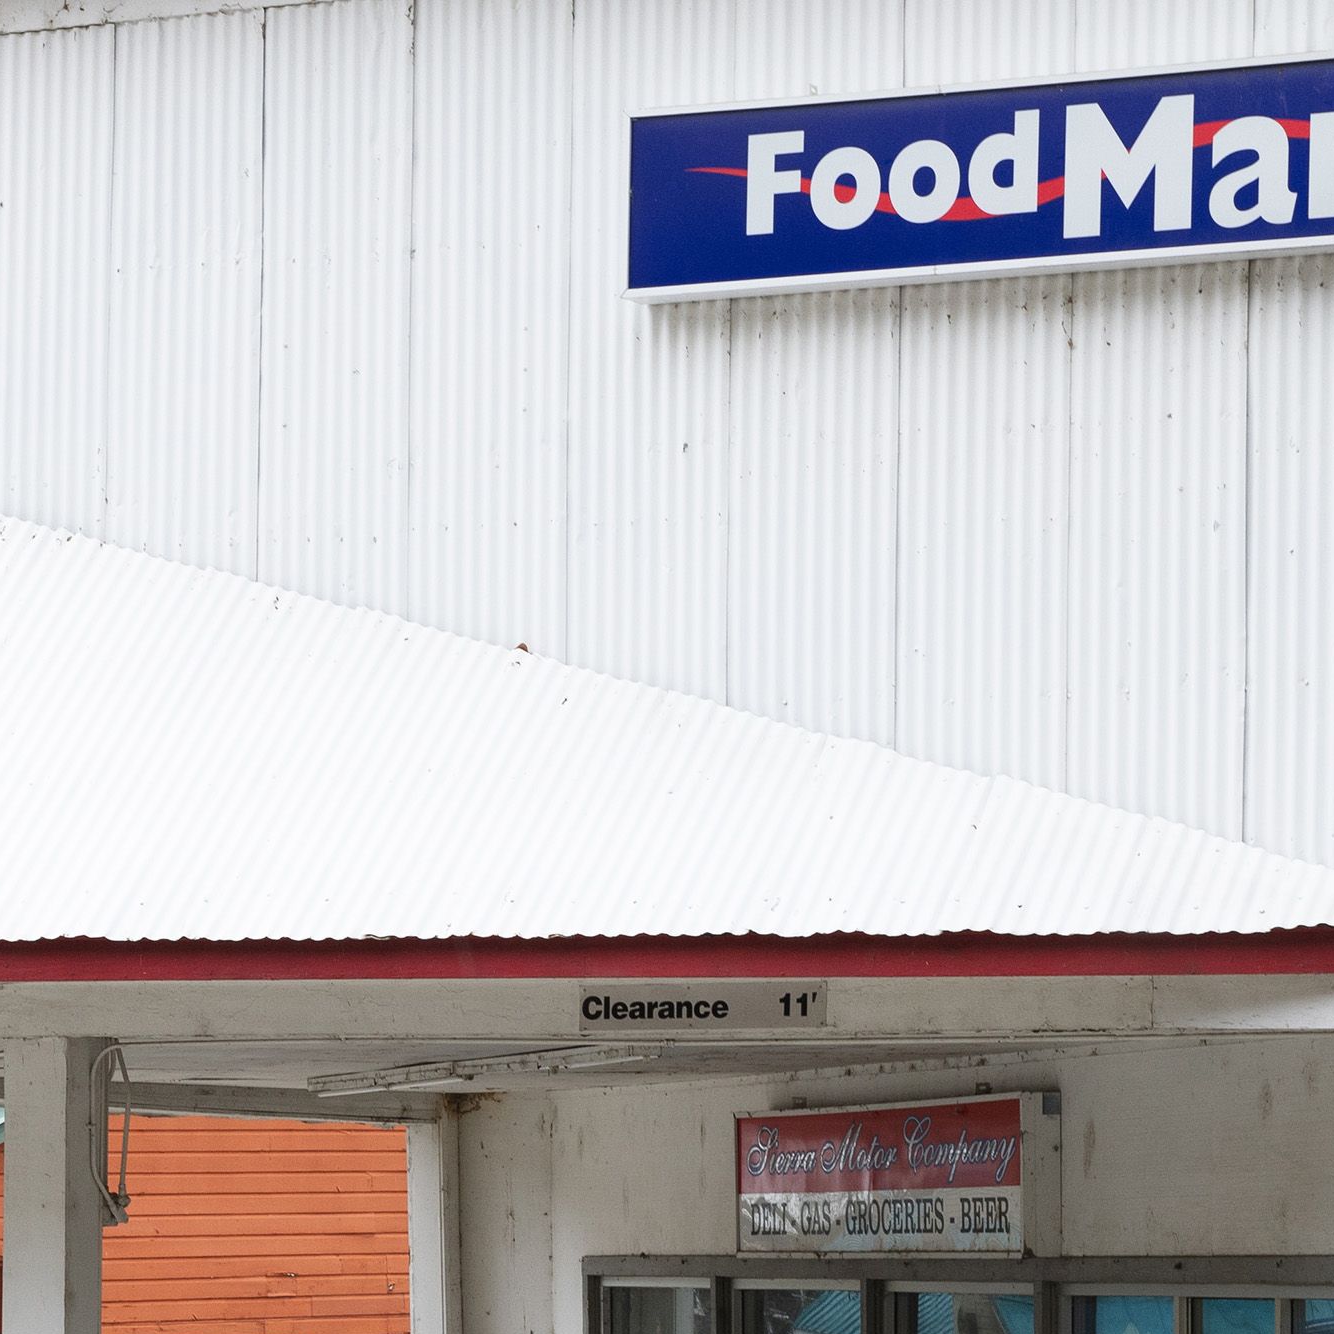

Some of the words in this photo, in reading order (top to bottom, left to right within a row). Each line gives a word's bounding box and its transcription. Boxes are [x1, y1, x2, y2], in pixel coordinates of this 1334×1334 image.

[582, 995, 729, 1020] Clearance
[779, 991, 818, 1017] 11'
[746, 1126, 817, 1176] Sierra
[819, 1120, 897, 1173] Motor
[903, 1115, 1016, 1184] Company
[750, 1201, 788, 1236] DELI
[800, 1201, 831, 1236] GAS
[845, 1197, 945, 1236] GROCERIES
[960, 1196, 1010, 1234] BEER
